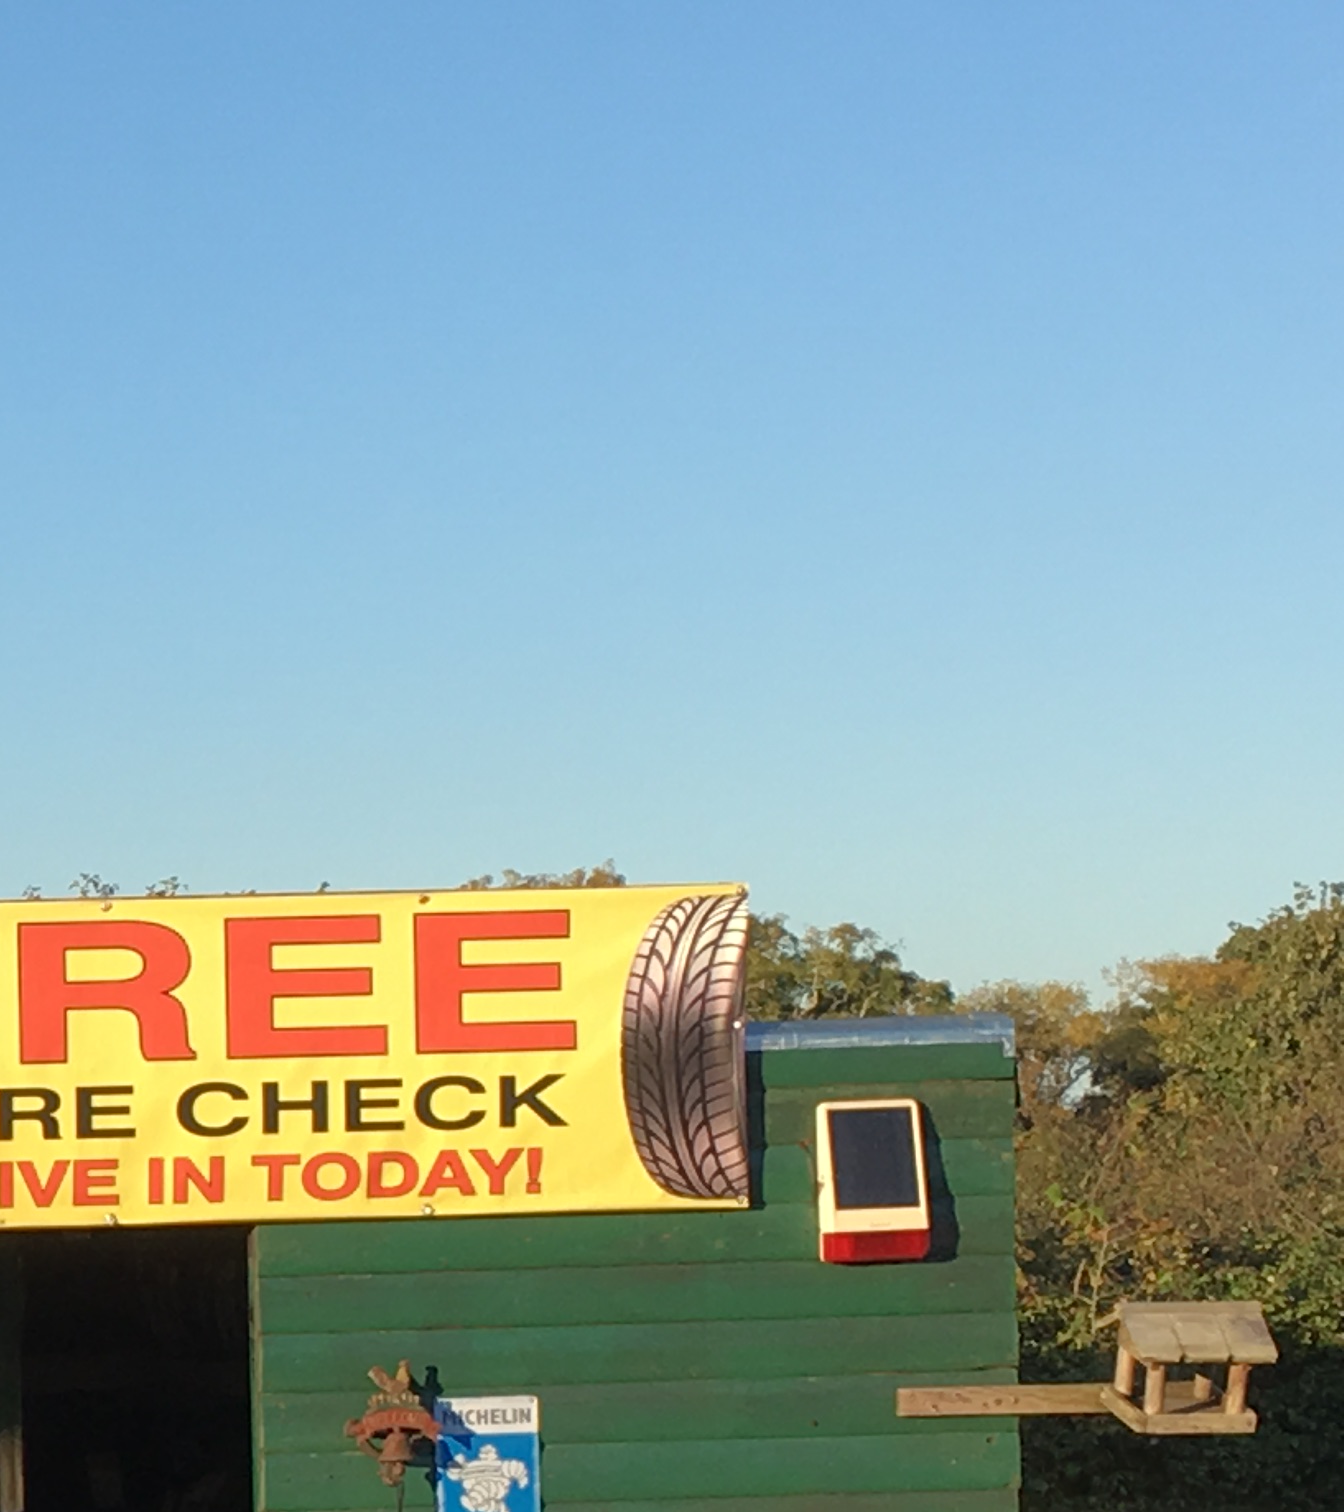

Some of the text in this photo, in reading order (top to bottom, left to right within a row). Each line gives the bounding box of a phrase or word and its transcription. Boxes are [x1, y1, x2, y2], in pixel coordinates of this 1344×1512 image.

[176, 1073, 570, 1138] CHECK
[148, 1155, 226, 1205] IN
[250, 1146, 544, 1201] TODAY!
[442, 1407, 532, 1426] MICHELIN
